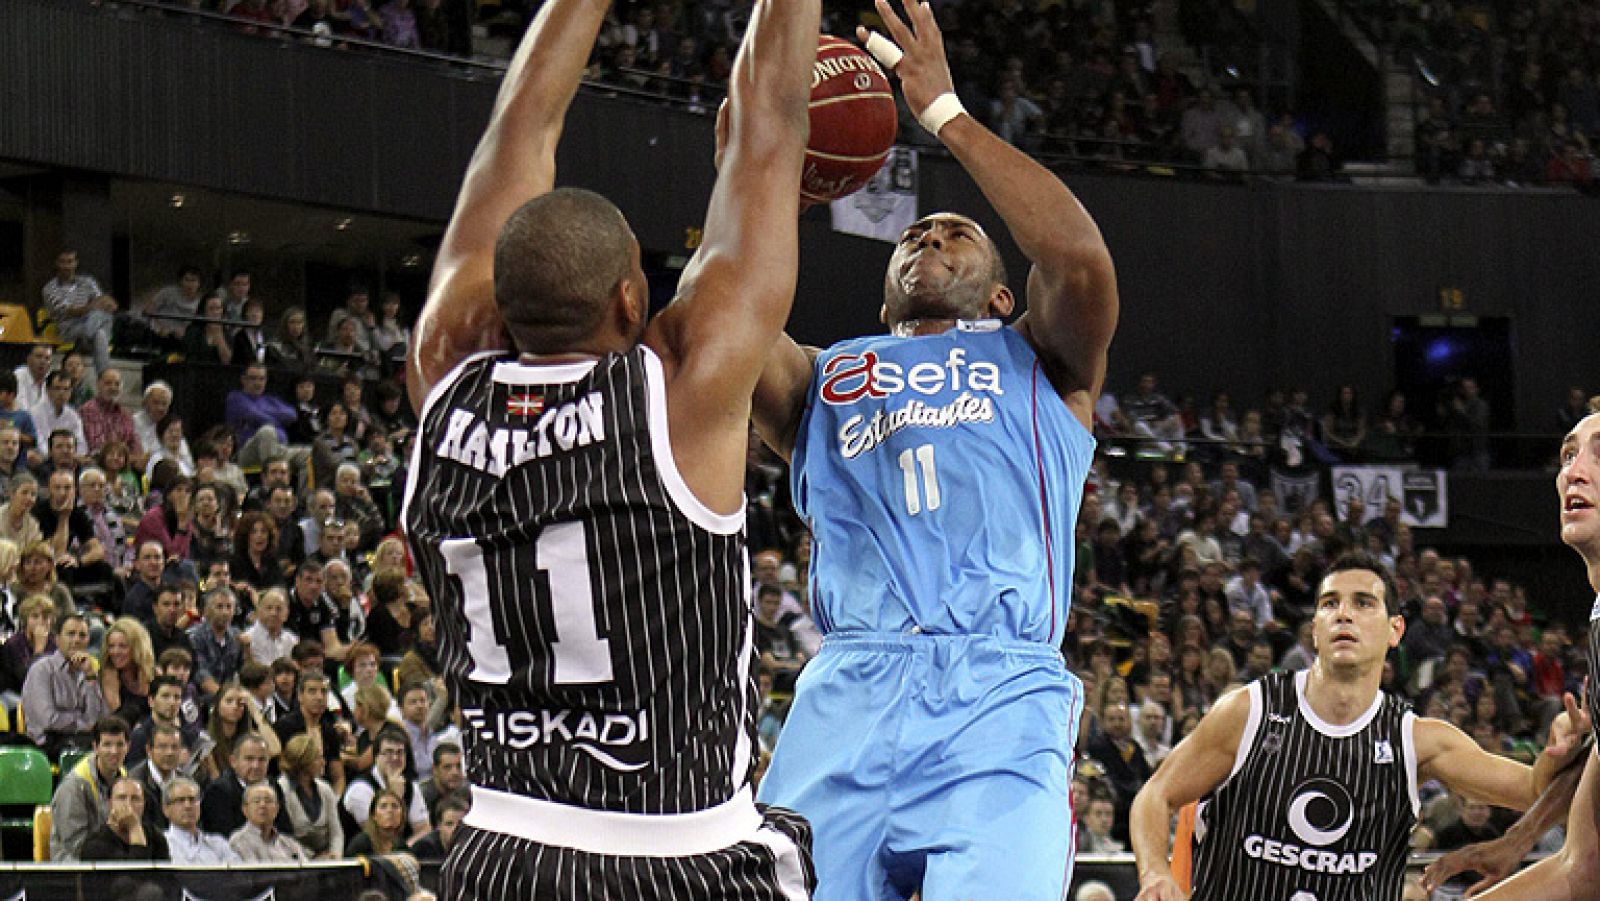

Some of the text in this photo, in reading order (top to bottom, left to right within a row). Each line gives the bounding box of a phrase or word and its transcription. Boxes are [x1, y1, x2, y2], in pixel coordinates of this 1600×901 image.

[821, 347, 1004, 404] asefa
[838, 391, 994, 459] Estudiantes
[899, 444, 941, 515] 11
[440, 520, 614, 685] 11
[1244, 835, 1377, 873] GESCRAP
